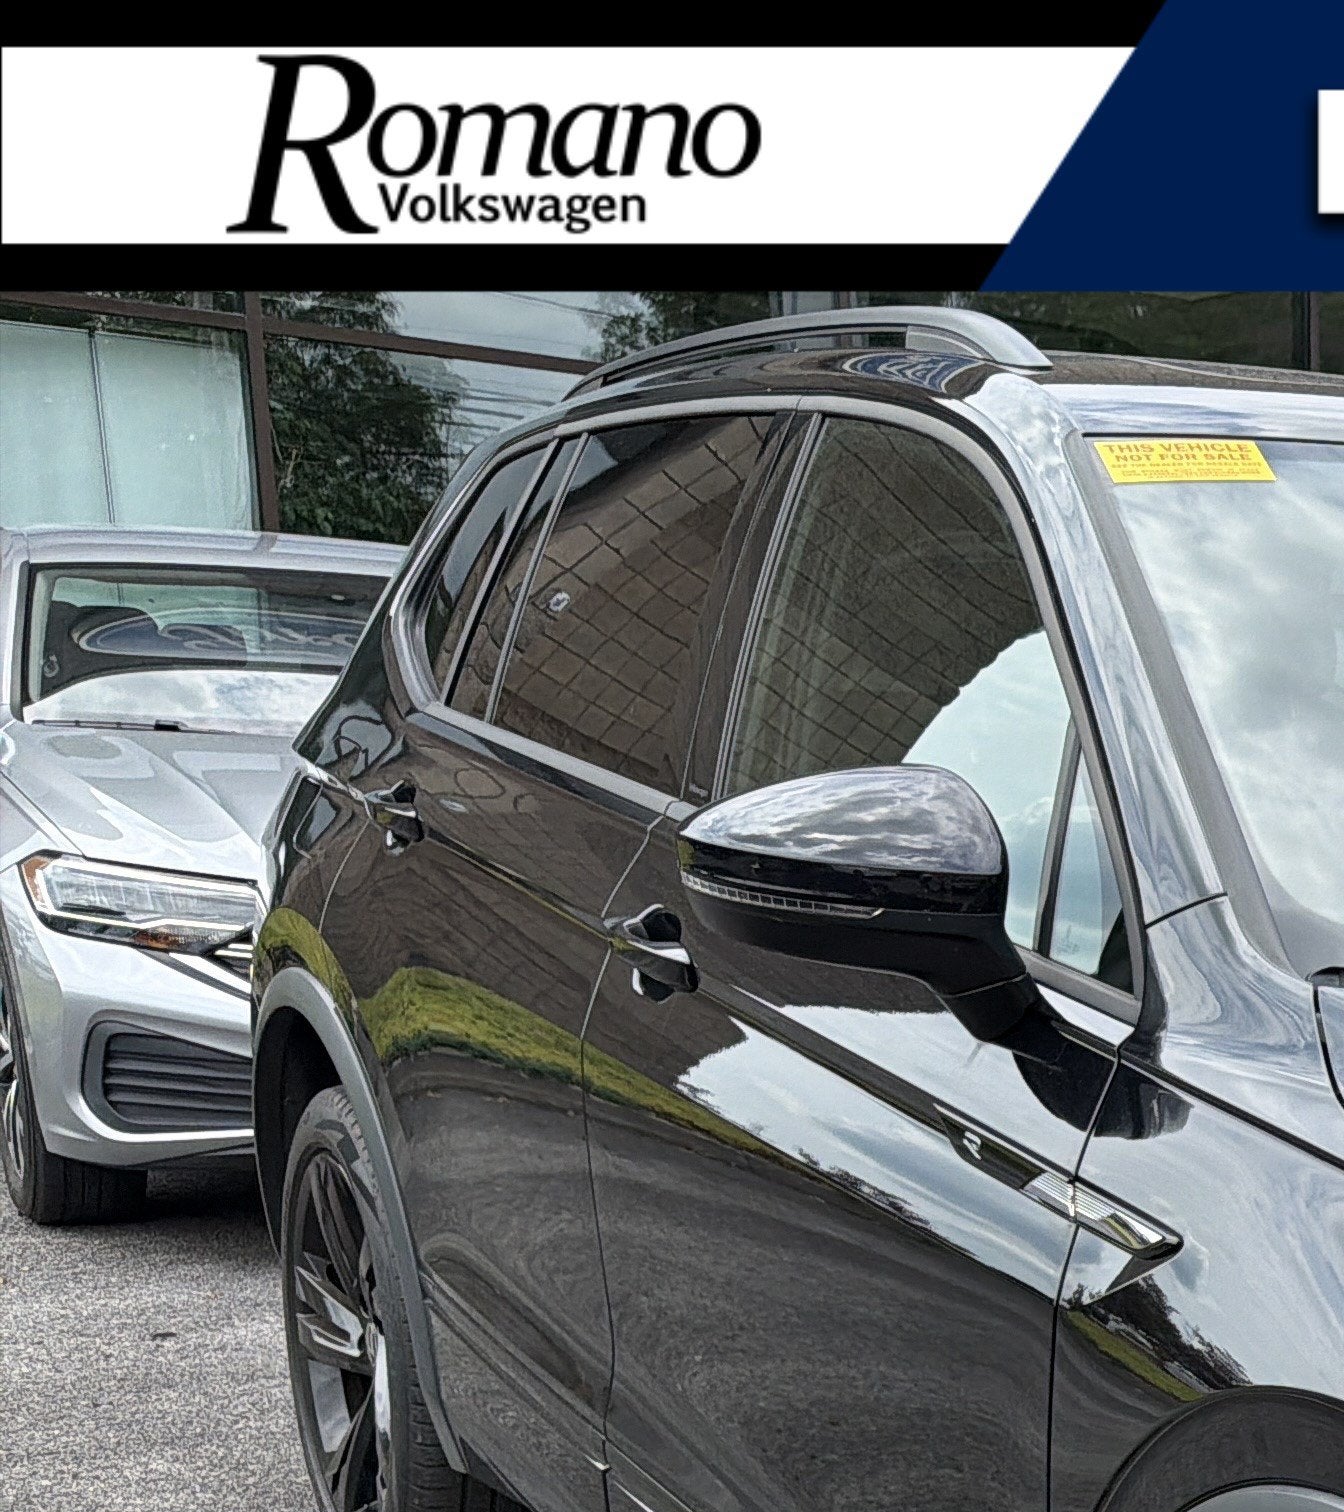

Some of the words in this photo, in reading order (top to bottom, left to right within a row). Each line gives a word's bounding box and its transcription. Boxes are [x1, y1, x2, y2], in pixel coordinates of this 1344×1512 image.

[1103, 444, 1154, 453] THIS
[1159, 443, 1252, 452] VEHICLE
[1115, 454, 1151, 462] NOT
[1158, 453, 1197, 461] FOR
[1203, 453, 1252, 461] SALE
